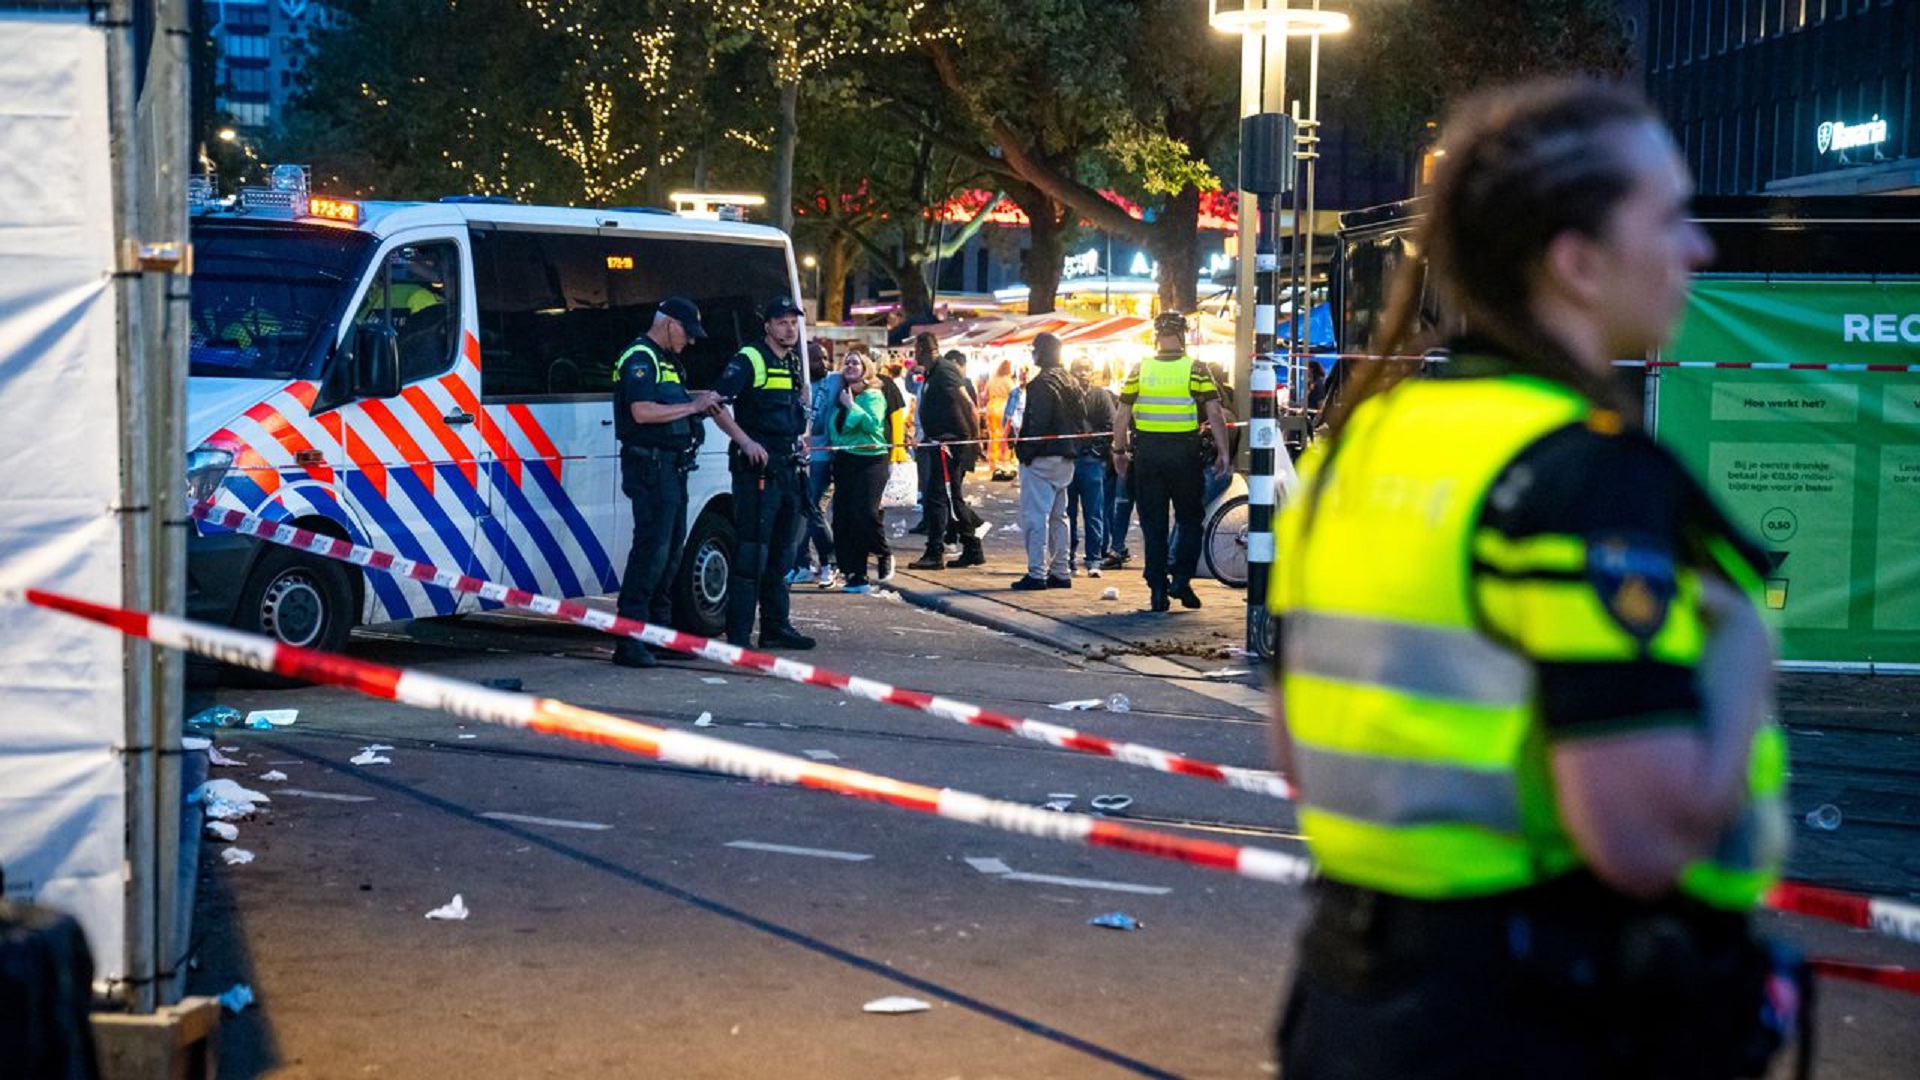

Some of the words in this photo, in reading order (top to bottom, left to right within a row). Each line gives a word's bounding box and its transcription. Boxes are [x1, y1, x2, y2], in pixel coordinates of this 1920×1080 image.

[1744, 399, 1764, 408] Hoe
[1768, 399, 1798, 408] werkt
[1802, 399, 1826, 408] het?
[1734, 461, 1746, 470] Bij
[1748, 462, 1757, 470] je
[1760, 462, 1790, 470] eerste
[1793, 461, 1830, 471] drankje
[1728, 471, 1757, 479] betaal
[1760, 472, 1769, 481] je
[1728, 482, 1768, 492] bijdrage
[1793, 484, 1803, 492] je
[1767, 521, 1791, 530] 0,50
